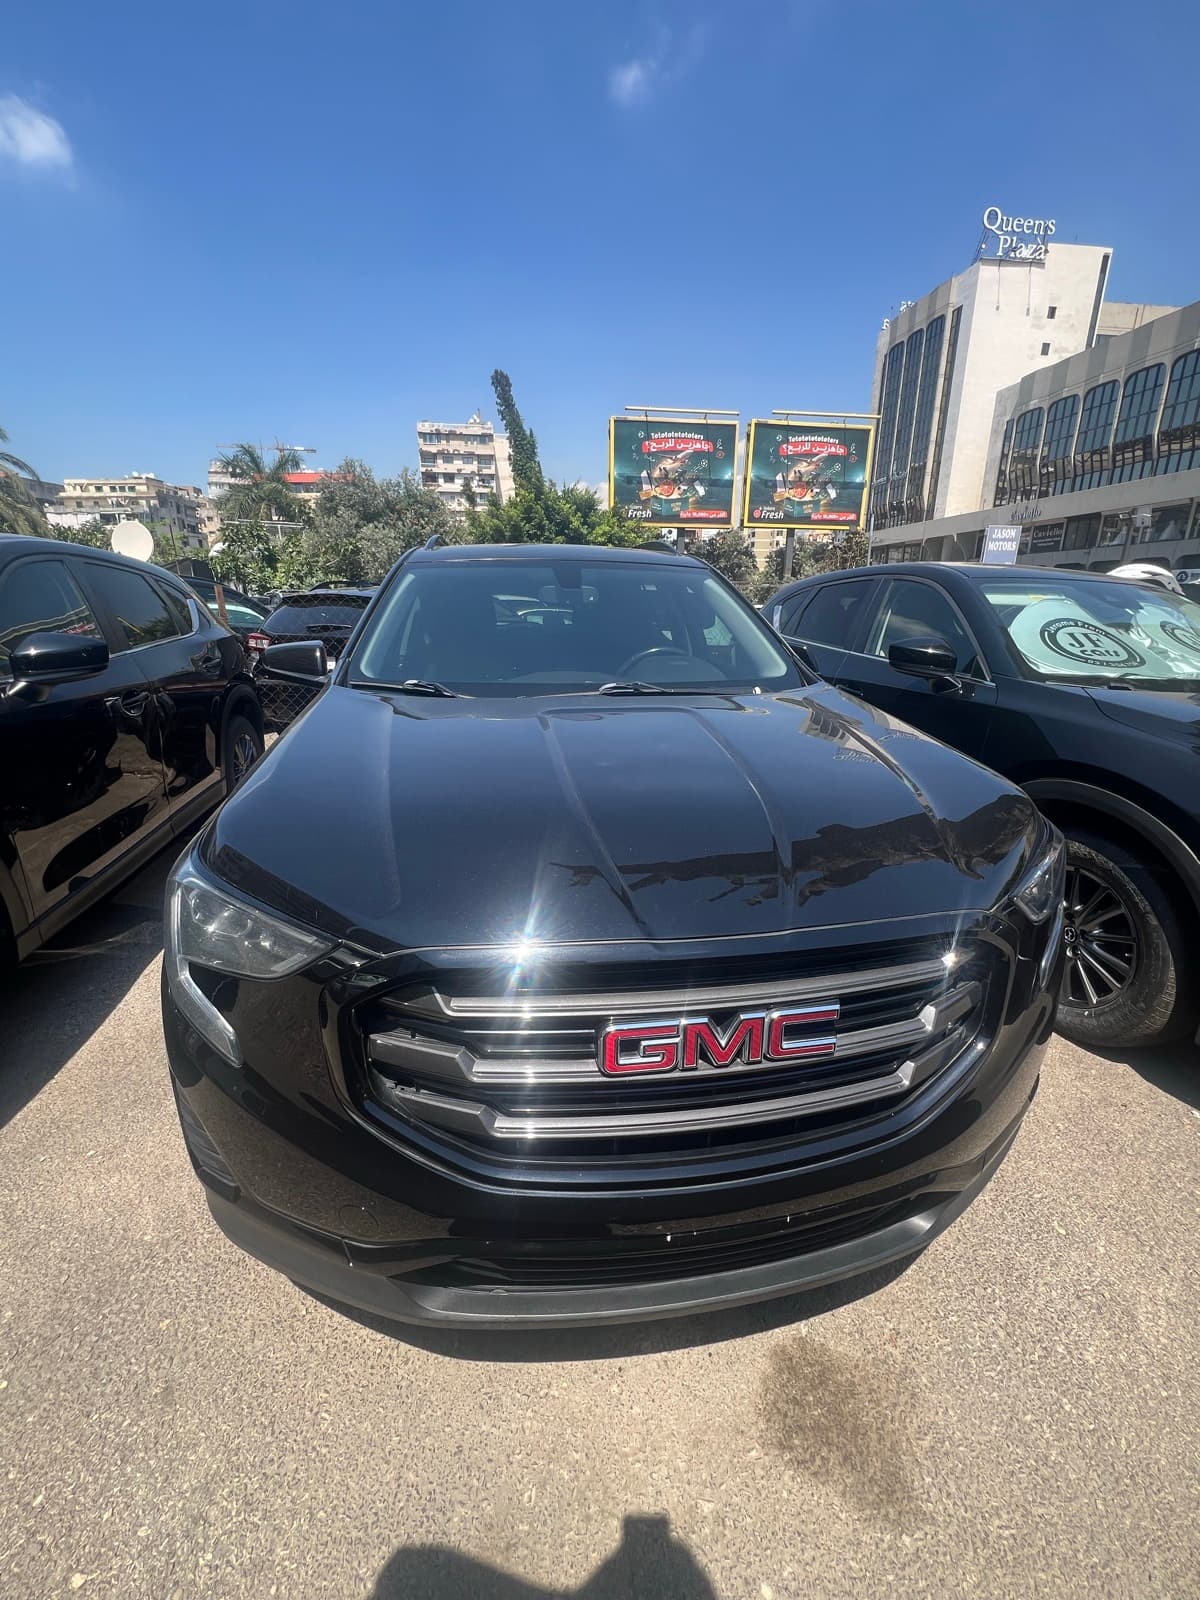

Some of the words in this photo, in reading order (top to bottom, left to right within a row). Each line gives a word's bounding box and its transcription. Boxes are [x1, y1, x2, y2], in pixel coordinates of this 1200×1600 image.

[676, 441, 710, 451] جاهزين
[812, 443, 845, 456] جاهزين
[628, 510, 651, 518] Fresh
[761, 510, 784, 519] Fresh
[993, 529, 1016, 538] JASON
[988, 542, 1016, 551] MOTORS
[1067, 633, 1104, 648] JF
[600, 1004, 841, 1077] GMC
